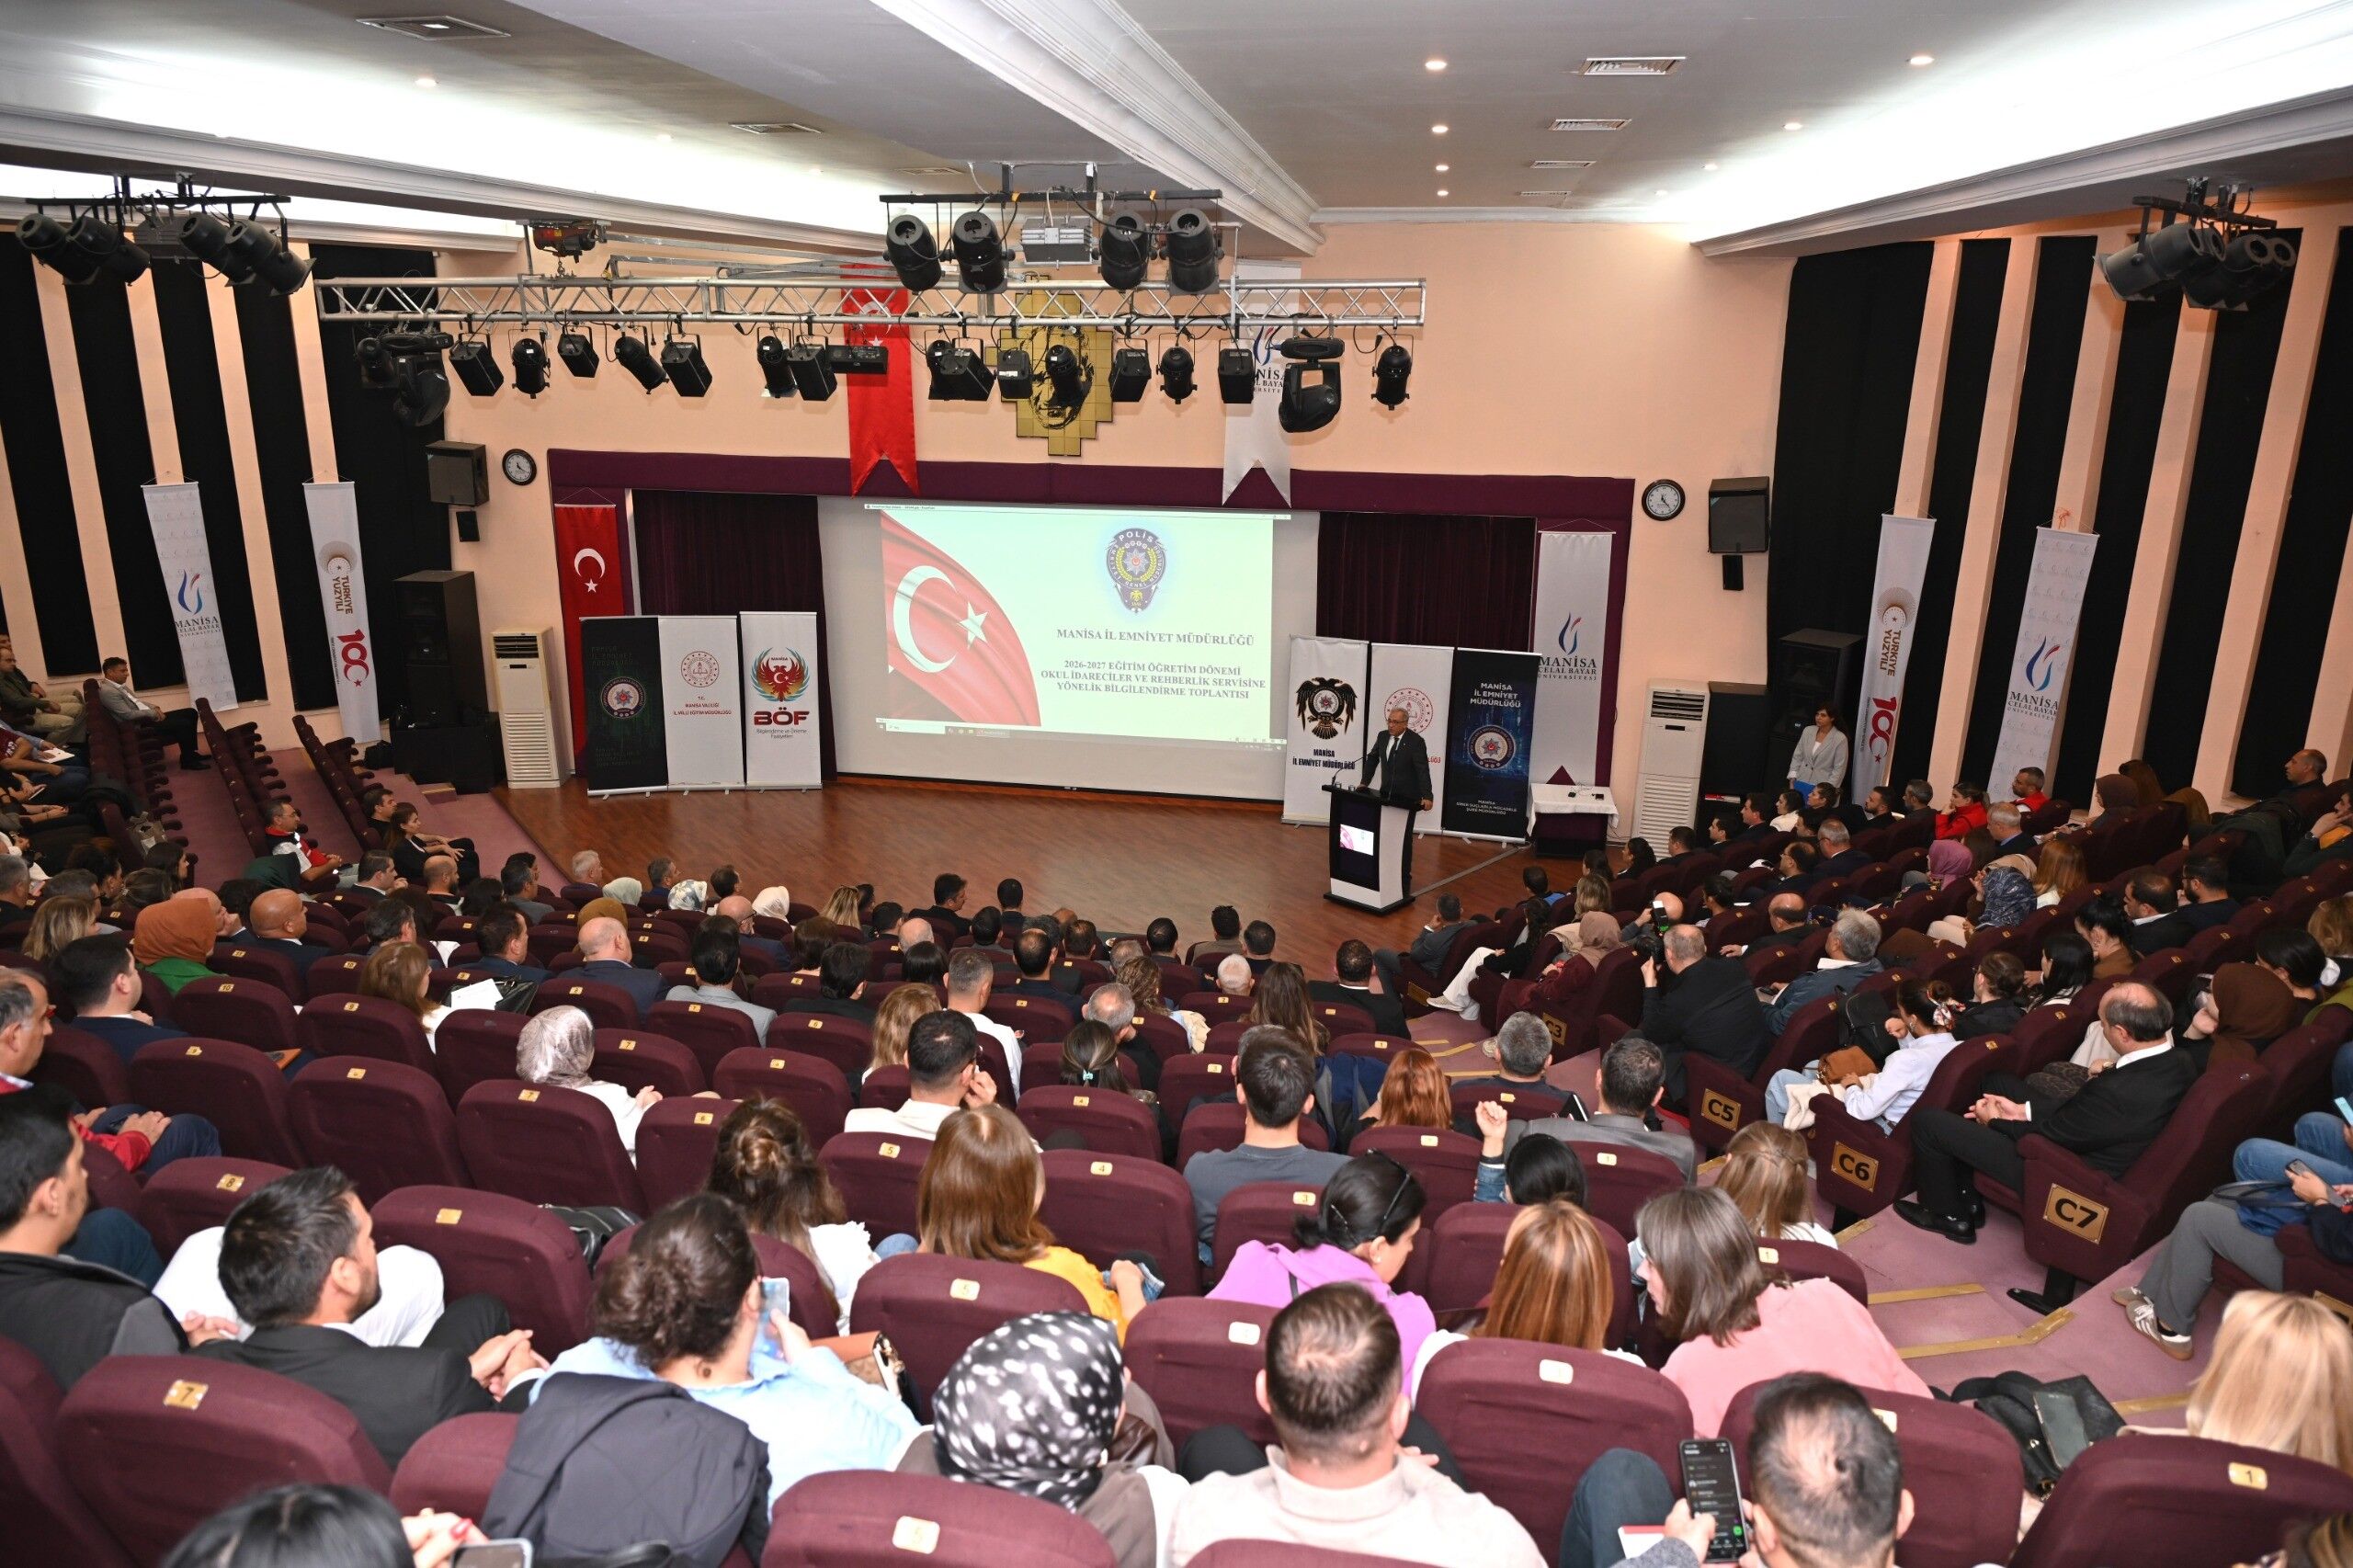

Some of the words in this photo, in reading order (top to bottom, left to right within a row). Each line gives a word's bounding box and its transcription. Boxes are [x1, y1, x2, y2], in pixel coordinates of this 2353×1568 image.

[1119, 531, 1154, 542] POLİS
[175, 616, 219, 629] MANİSA
[1057, 629, 1102, 641] MANİSA
[1105, 631, 1117, 641] İL
[1119, 631, 1174, 643] EMNİYET
[1176, 632, 1255, 646] MÜDÜRLÜĞÜ
[1064, 660, 1106, 670] 2026-2027
[1108, 661, 1145, 672] EĞİTİM
[1148, 662, 1197, 674] ÖĞRETİM
[1199, 665, 1241, 676] DÖNEMİ
[1539, 655, 1597, 668] MANİSA
[1040, 669, 1069, 679] OKUL
[1071, 671, 1132, 682] İDARECİLER
[1135, 674, 1148, 683] VE
[1151, 675, 1210, 686] REHBERLİK
[1212, 676, 1266, 688] SERVİSİNE
[1481, 682, 1513, 691] MANİSA
[1057, 681, 1102, 692] YÖNELİK
[1105, 683, 1186, 696] BİLGİLENDİRME
[1188, 688, 1250, 699] TOPLANTISI
[1474, 688, 1481, 697] İL
[1483, 690, 1518, 699] EMNİYET
[1471, 698, 1521, 709] MÜDÜRLÜĞÜ
[2010, 690, 2058, 710] MANİSA
[754, 706, 811, 726] BÖF
[1313, 748, 1336, 757] MANİSA
[1292, 756, 1298, 765] İL
[1299, 757, 1322, 767] EMNİYET
[1545, 1020, 1563, 1039] C3
[1708, 1098, 1735, 1122] C5
[1838, 1153, 1870, 1181] C6
[2054, 1198, 2098, 1229] C7
[180, 1385, 196, 1403] 7
